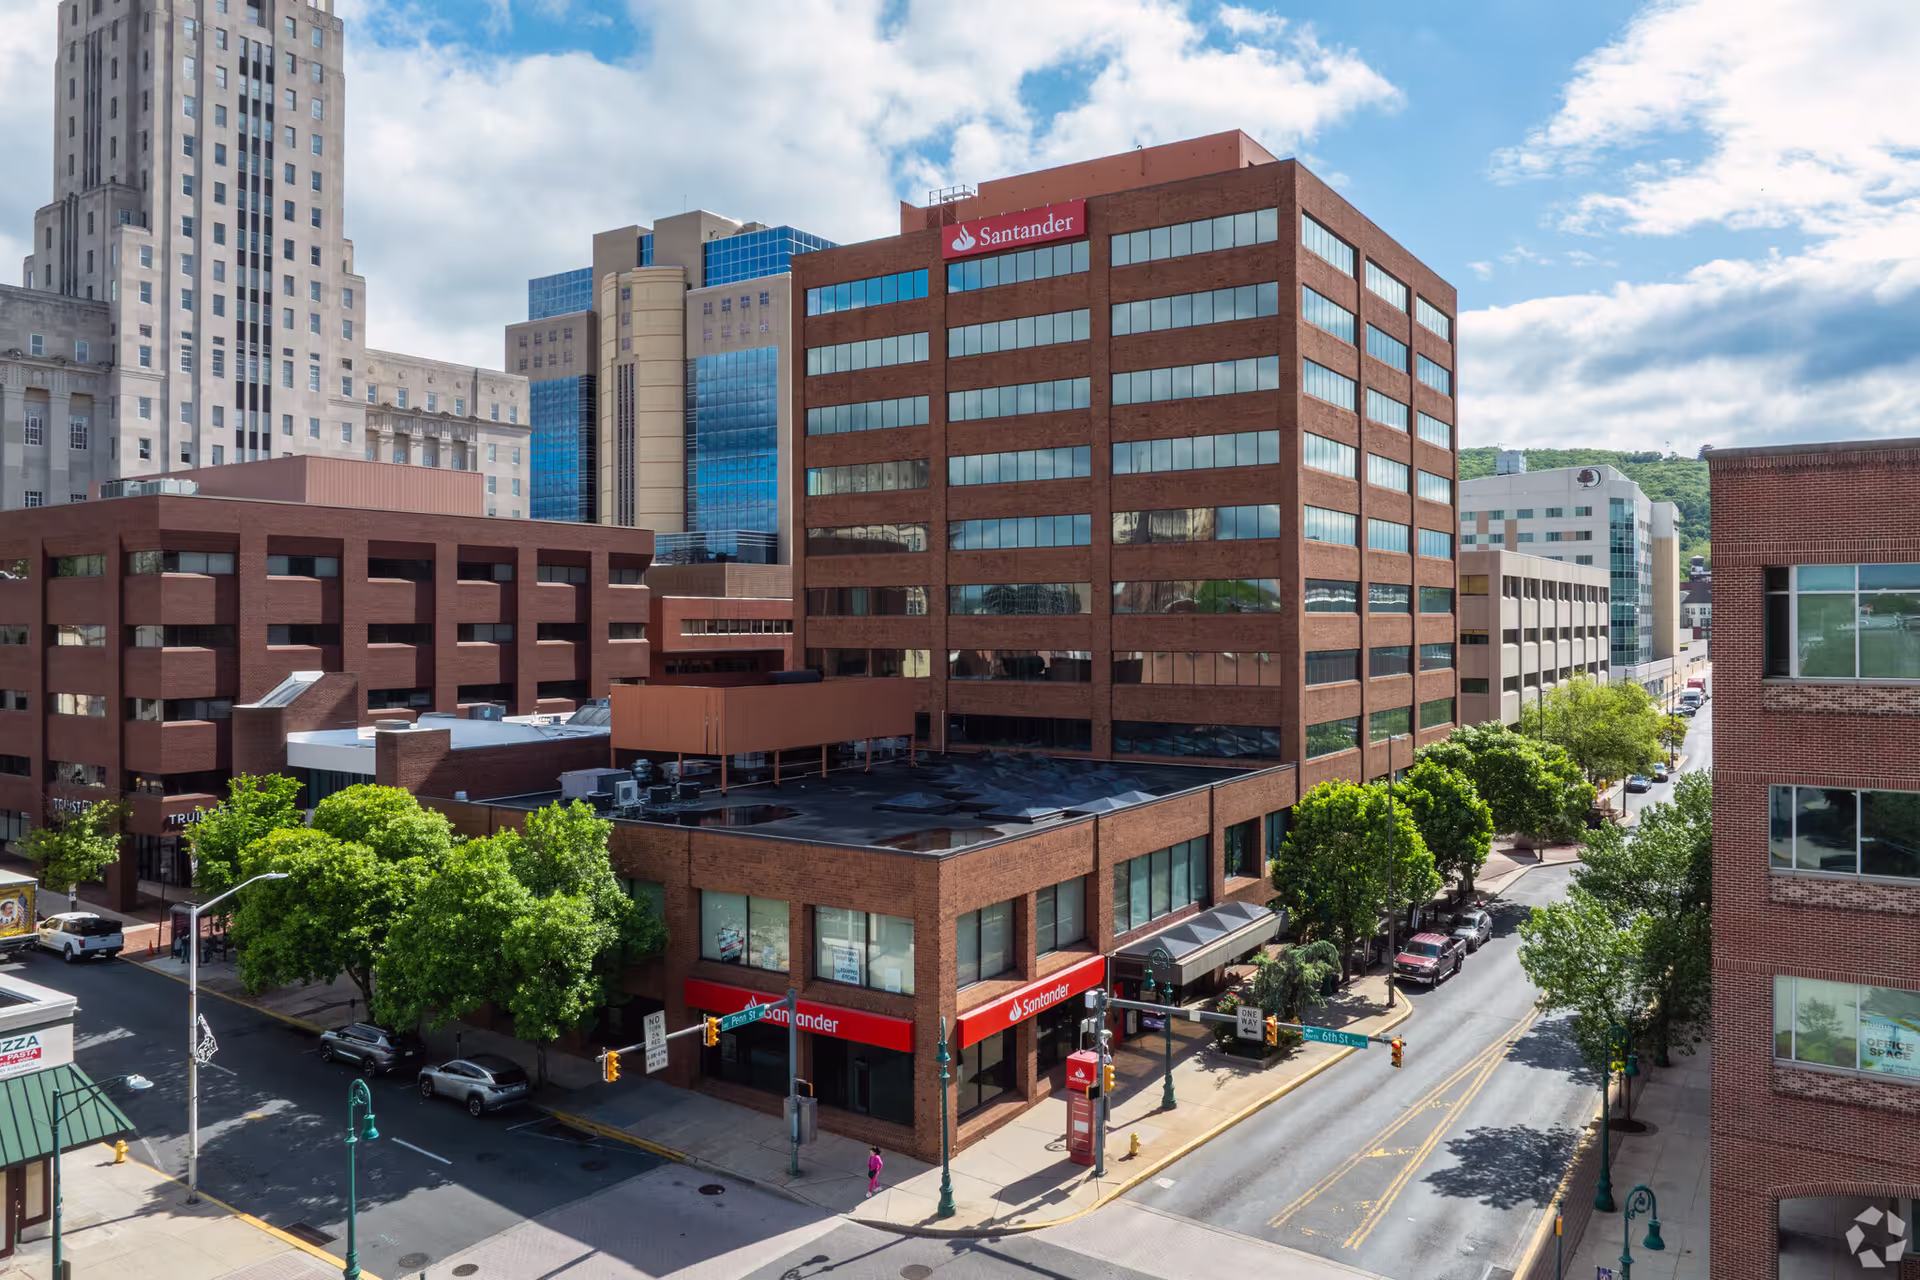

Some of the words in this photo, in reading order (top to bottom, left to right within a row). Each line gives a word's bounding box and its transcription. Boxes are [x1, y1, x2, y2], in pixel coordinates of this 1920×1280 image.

[980, 213, 1073, 246] Santander
[1023, 983, 1069, 1016] Santander
[648, 1015, 660, 1025] NO
[731, 1014, 747, 1026] Penn
[748, 1010, 756, 1020] St
[764, 1006, 839, 1033] Sanander
[1242, 1009, 1258, 1018] ONE
[1241, 1017, 1258, 1026] WAY
[1322, 1032, 1338, 1043] 6th
[1339, 1034, 1348, 1044] St
[1351, 1039, 1366, 1047] South
[1866, 1038, 1915, 1052] OFFICE
[7, 1049, 38, 1061] PASTA
[1869, 1047, 1911, 1060] SPACE
[1068, 1075, 1091, 1085] Santander
